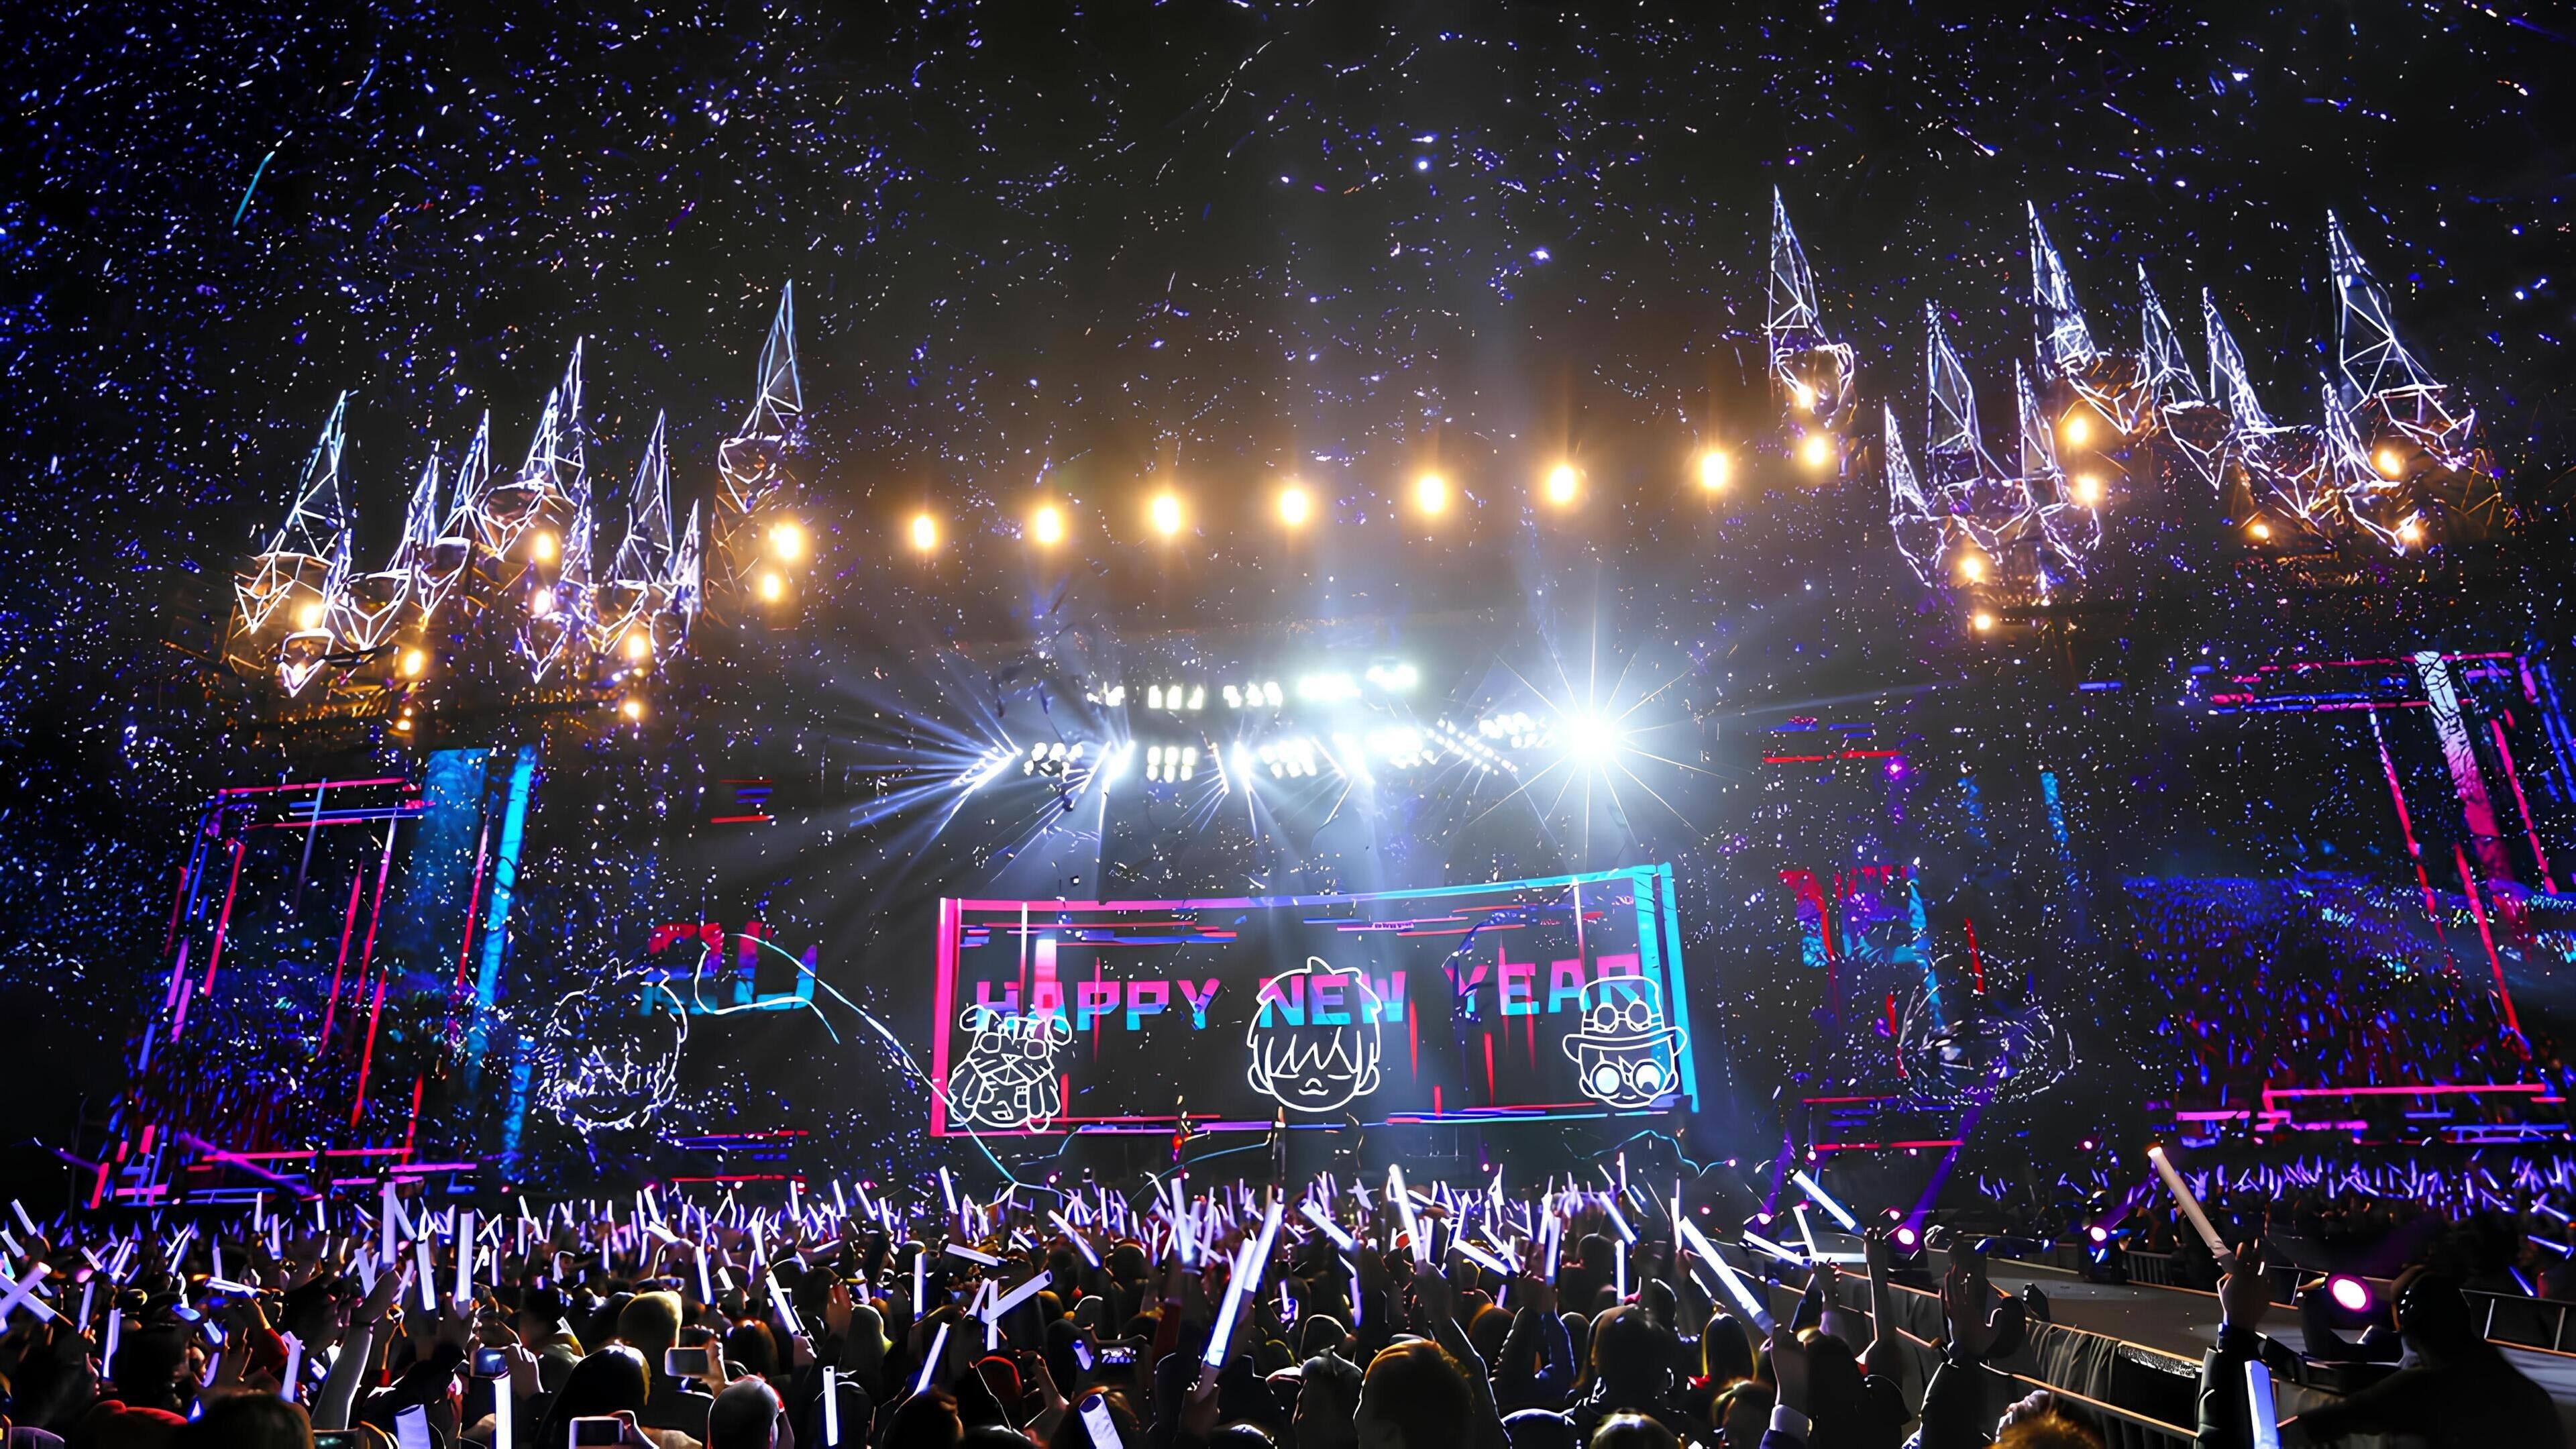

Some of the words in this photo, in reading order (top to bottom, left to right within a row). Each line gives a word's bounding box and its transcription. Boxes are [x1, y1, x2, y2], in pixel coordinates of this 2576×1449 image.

[976, 978, 1220, 1032] HAPPY
[1258, 971, 1406, 1028] NEW
[1444, 953, 1642, 1016] YEAR
